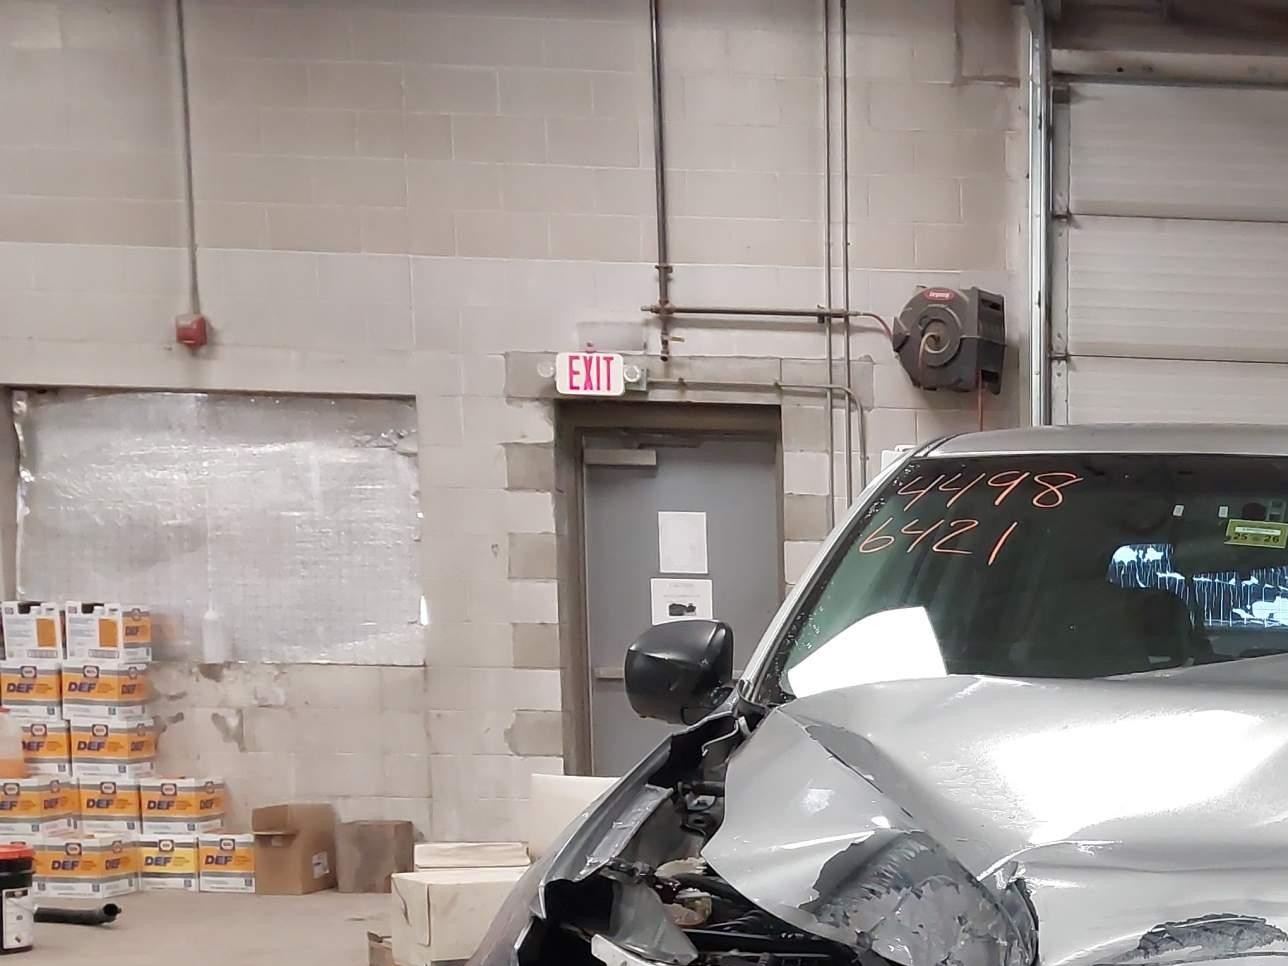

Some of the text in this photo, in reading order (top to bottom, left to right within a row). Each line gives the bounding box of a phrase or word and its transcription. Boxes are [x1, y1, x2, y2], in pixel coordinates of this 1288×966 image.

[568, 355, 614, 391] EXIT
[897, 471, 1084, 512] 4498
[859, 517, 1018, 566] 6421
[1233, 532, 1280, 543] 25 26
[7, 683, 34, 693] DEF
[68, 682, 96, 692] DEF
[78, 741, 105, 751] DEF
[86, 799, 113, 808] DEF
[147, 800, 175, 810] DEF
[51, 860, 79, 870] DEF
[144, 856, 172, 866] DEF
[204, 855, 232, 865] DEF
